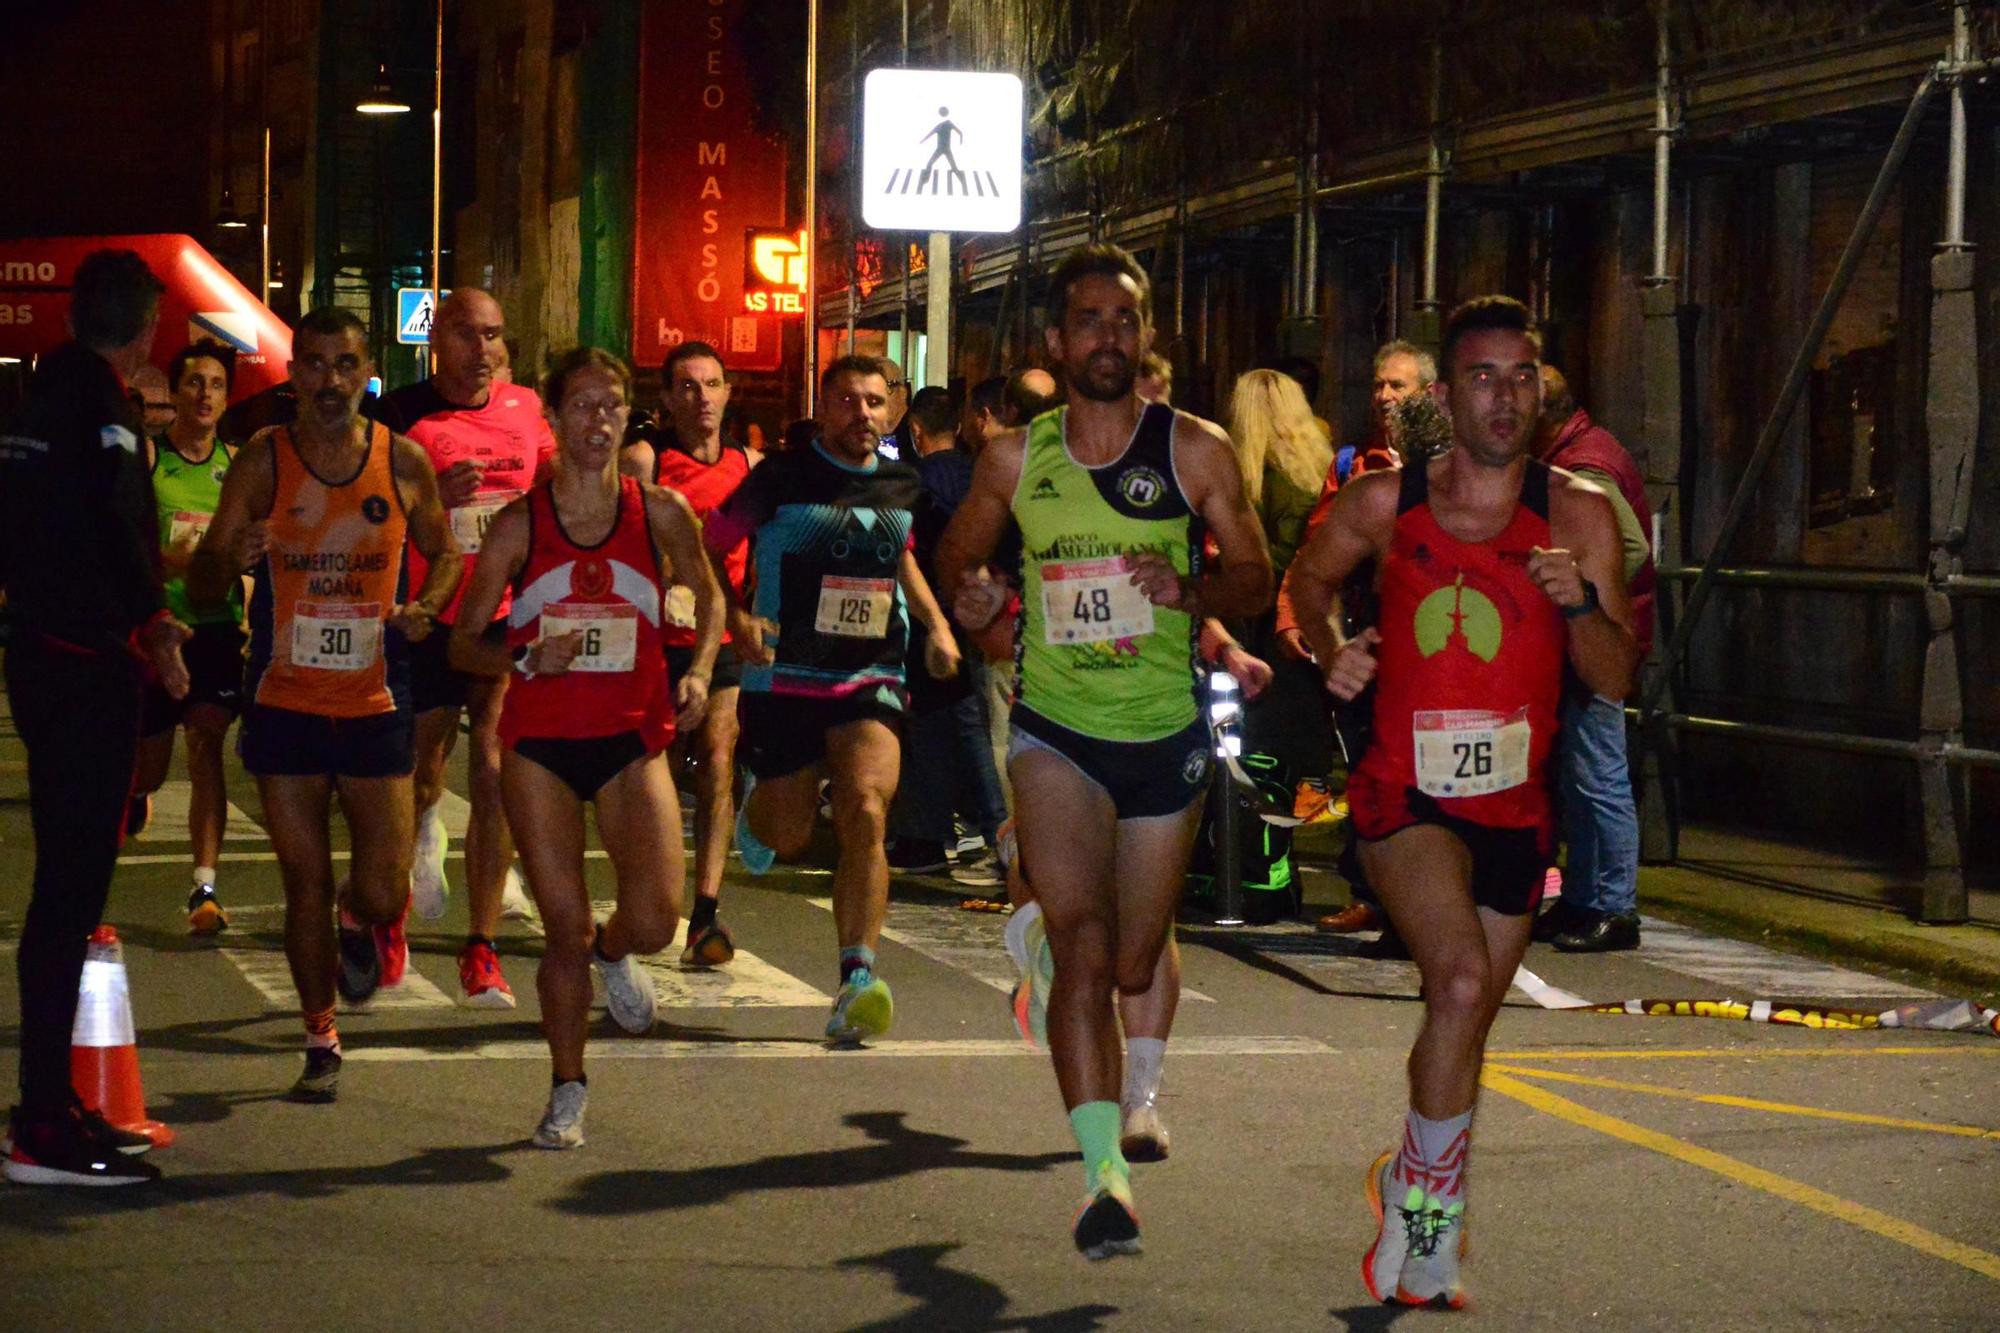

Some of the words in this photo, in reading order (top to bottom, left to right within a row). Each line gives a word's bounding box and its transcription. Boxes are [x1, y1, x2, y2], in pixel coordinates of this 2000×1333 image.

[703, 0, 724, 109] SEO
[698, 142, 726, 302] MASSÓ
[309, 575, 364, 597] MOAÑA
[838, 598, 872, 624] 126
[1073, 588, 1111, 624] 48
[319, 627, 352, 656] 30
[1453, 742, 1493, 779] 26
